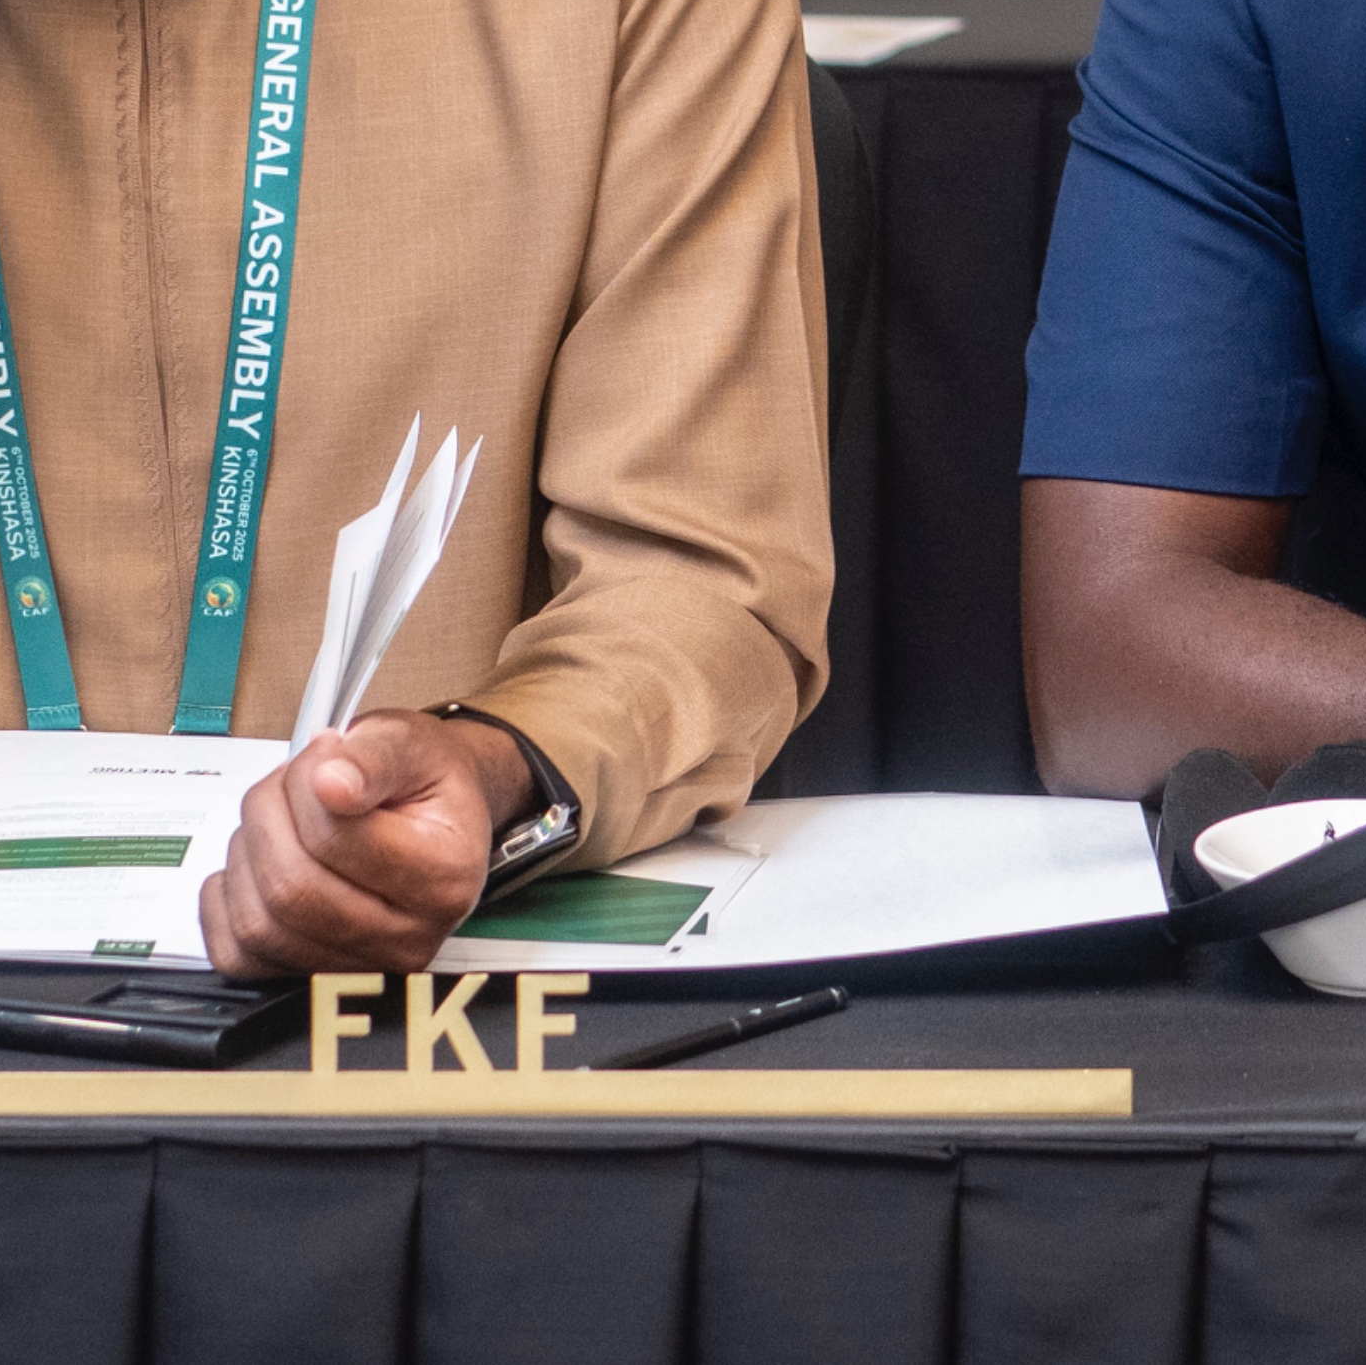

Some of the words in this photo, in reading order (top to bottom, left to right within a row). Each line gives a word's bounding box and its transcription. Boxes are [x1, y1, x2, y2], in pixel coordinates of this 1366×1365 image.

[228, 199, 284, 440] ASSEMBLY
[15, 467, 34, 526] OCTOBER
[25, 527, 41, 559] 2025
[209, 445, 243, 559] KINSHASA
[232, 529, 247, 561] 2025
[236, 469, 255, 529] OCTOBER
[311, 973, 590, 1072] FKF
